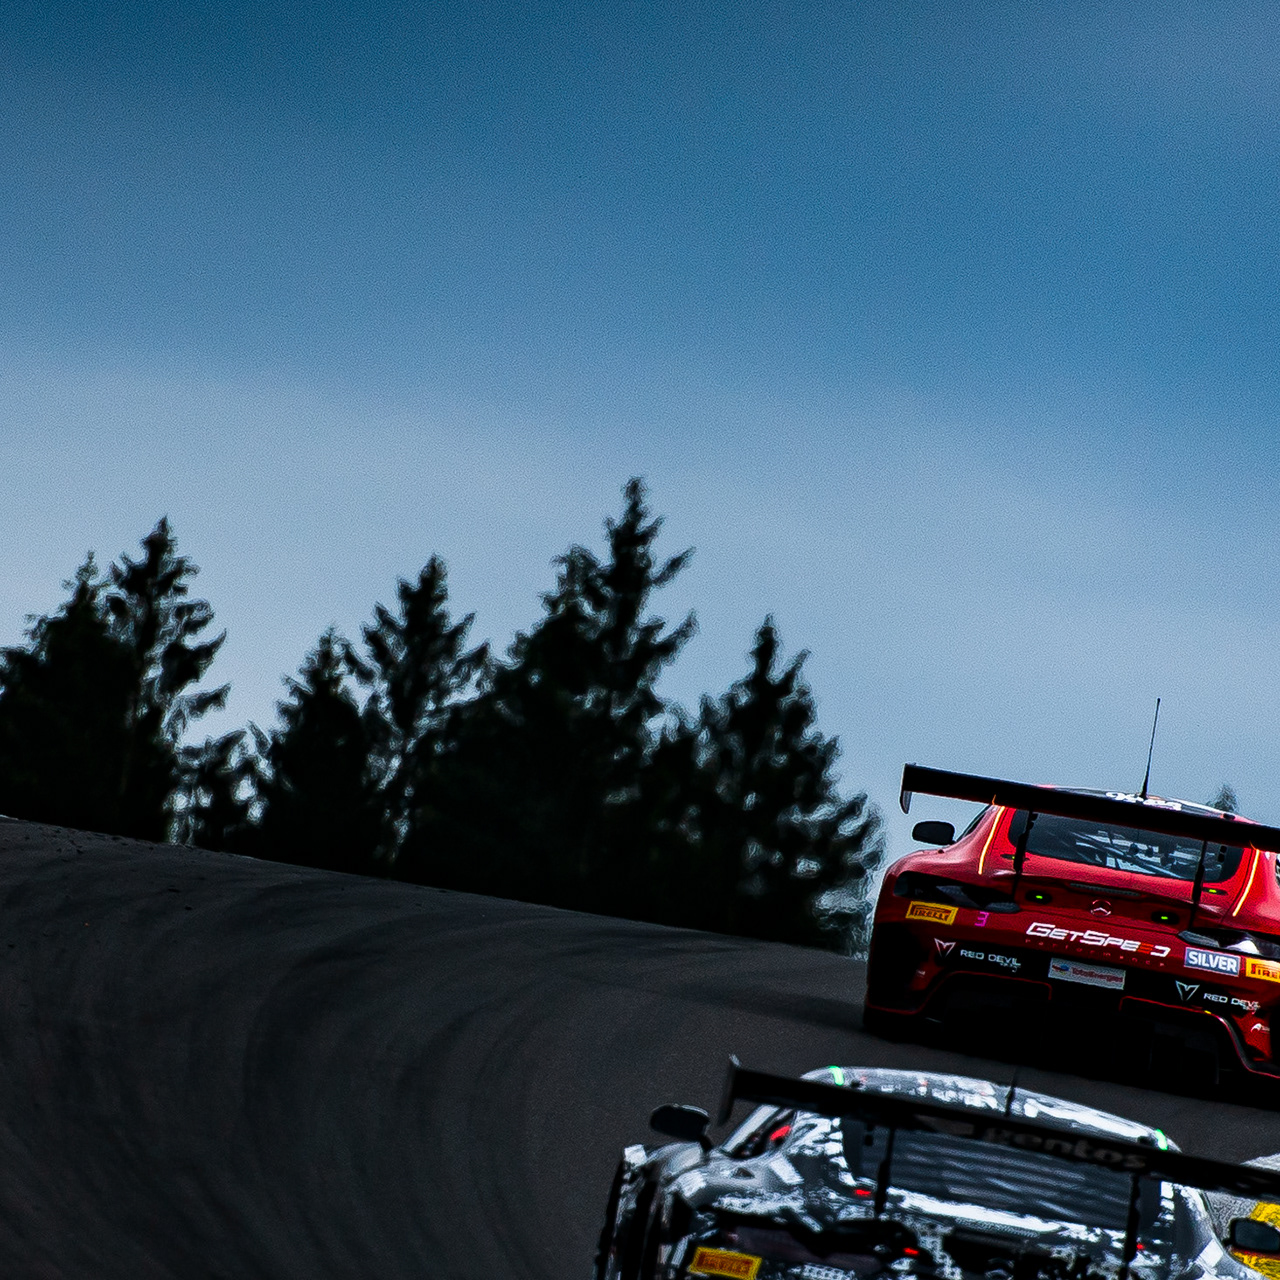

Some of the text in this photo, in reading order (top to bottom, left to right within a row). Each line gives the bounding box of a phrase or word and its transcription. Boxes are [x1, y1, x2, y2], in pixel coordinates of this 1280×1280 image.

[974, 910, 990, 927] 3
[959, 949, 1022, 967] RED DEVIL
[1188, 950, 1238, 973] SILVER
[1202, 992, 1229, 1004] RED
